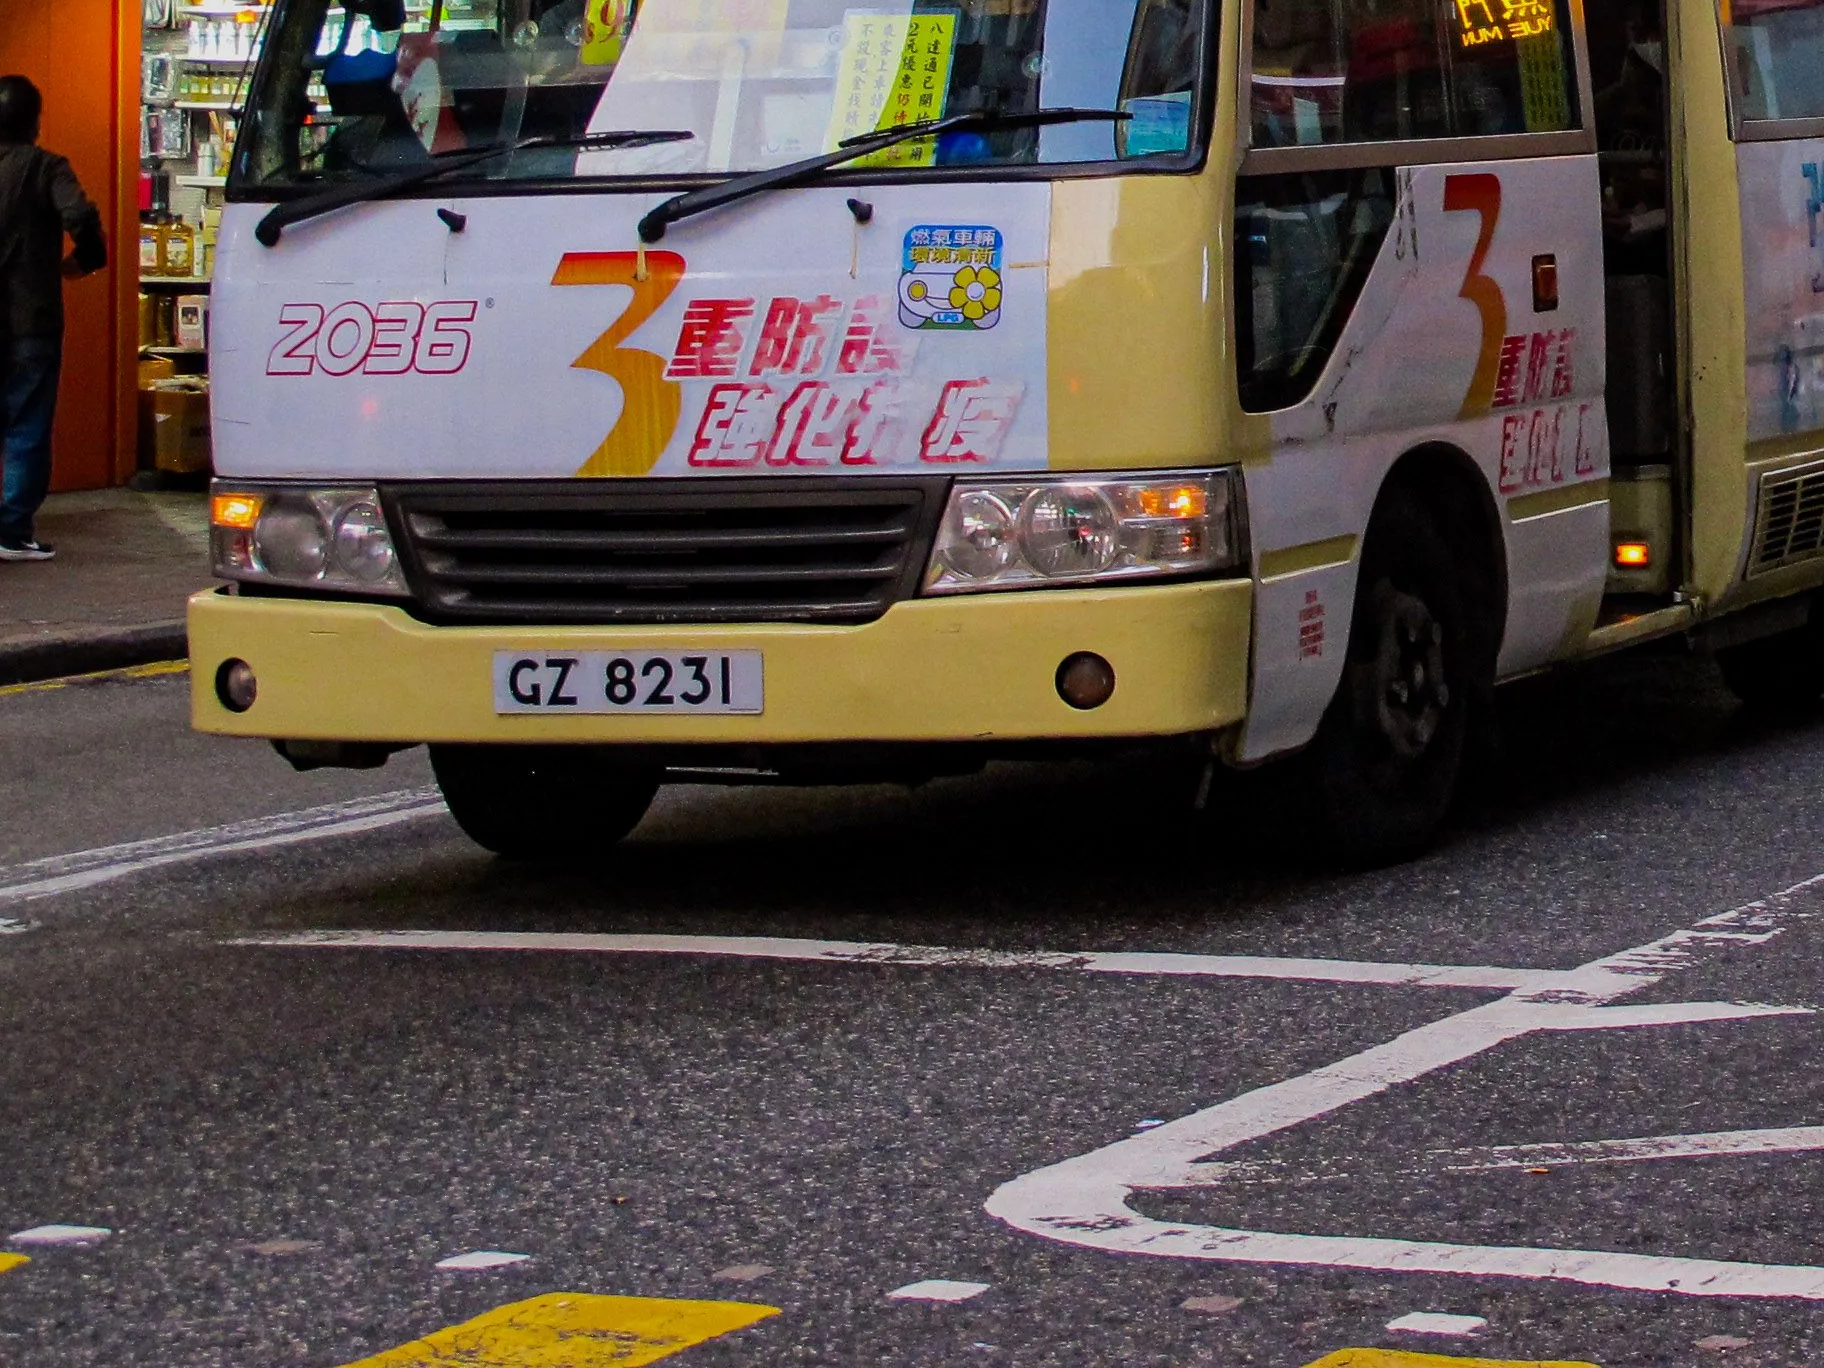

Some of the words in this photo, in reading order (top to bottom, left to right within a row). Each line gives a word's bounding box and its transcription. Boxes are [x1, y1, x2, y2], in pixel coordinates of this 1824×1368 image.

[266, 300, 478, 376] 2036
[548, 250, 686, 478] 3
[1443, 172, 1509, 421] 3
[508, 657, 578, 708] GZ
[604, 656, 733, 707] 8231
